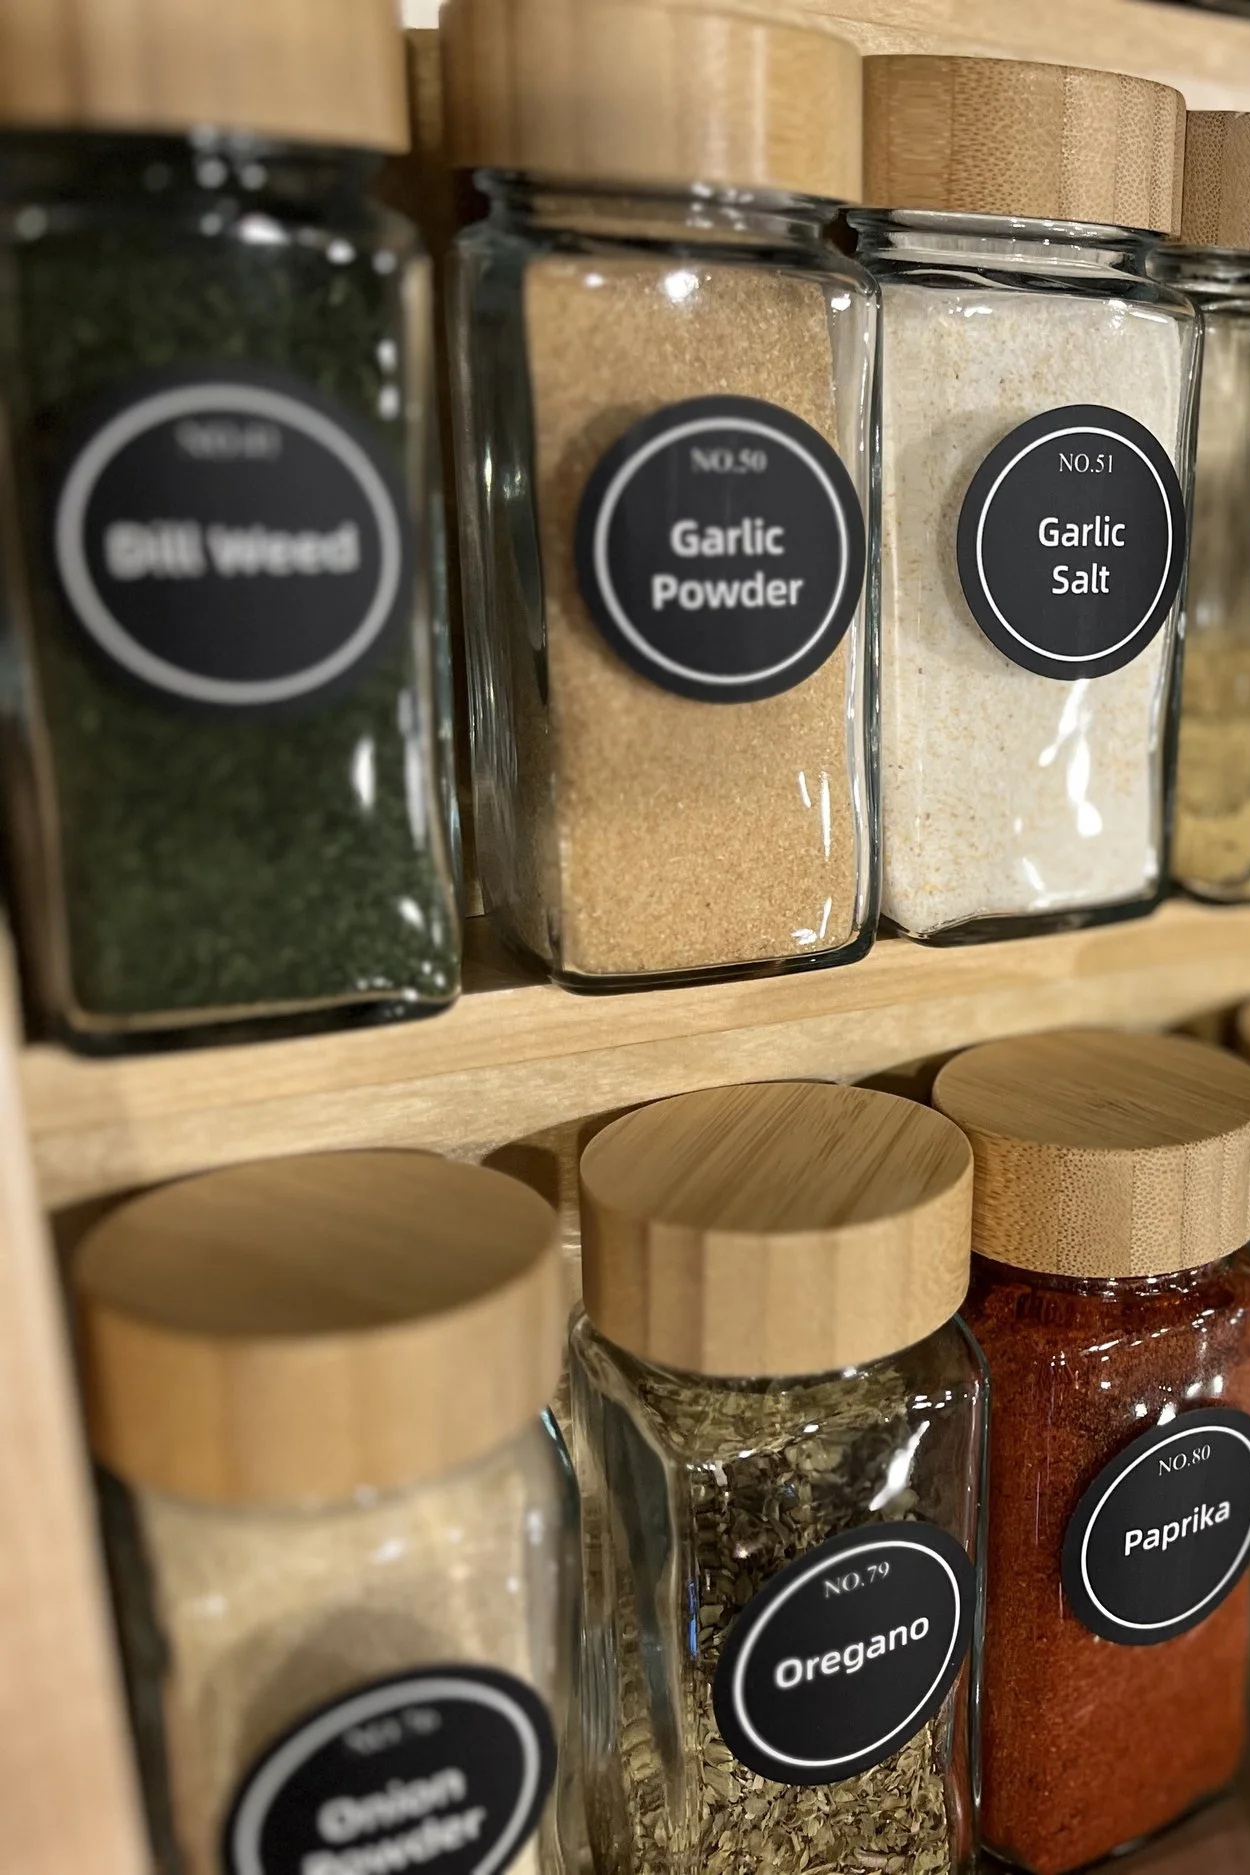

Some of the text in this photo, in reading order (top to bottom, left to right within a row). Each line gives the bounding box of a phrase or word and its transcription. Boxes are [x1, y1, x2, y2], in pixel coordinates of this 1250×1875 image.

[691, 447, 768, 474] NO.50
[1059, 452, 1114, 474] NO.51
[671, 517, 783, 557] Garlic
[1038, 516, 1126, 547] Garlic
[652, 571, 804, 611] Powder
[1051, 562, 1110, 596] Salt
[1157, 1443, 1212, 1477] NO.80
[1124, 1500, 1232, 1557] Paprika
[823, 1560, 891, 1599] NO.79
[773, 1614, 931, 1692] Oregano
[317, 1767, 467, 1844] Onion
